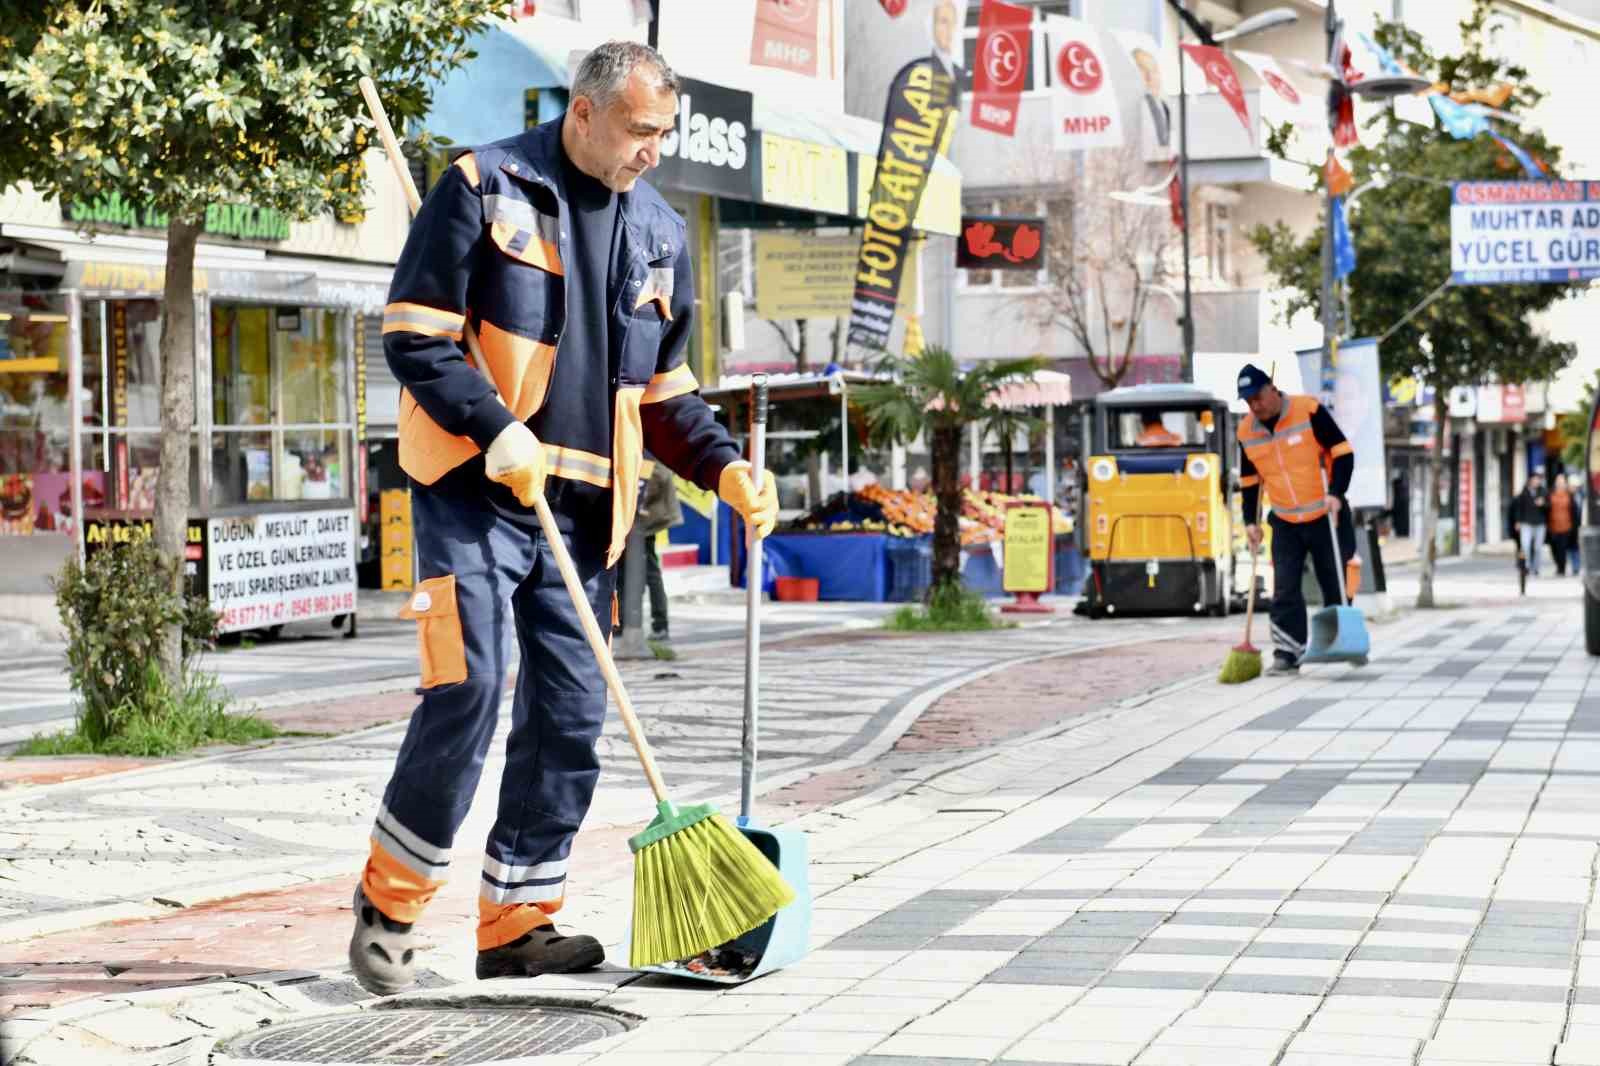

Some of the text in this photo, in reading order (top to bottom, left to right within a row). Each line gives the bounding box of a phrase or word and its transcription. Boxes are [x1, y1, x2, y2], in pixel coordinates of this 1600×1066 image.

[1063, 115, 1112, 134] MHP
[1471, 208, 1563, 230] MUHTAR
[1459, 235, 1539, 264] YÜCEL
[317, 515, 349, 534] DAVET
[218, 554, 233, 571] VE
[237, 549, 267, 569] ÖZEL
[213, 579, 245, 600] TOPLU
